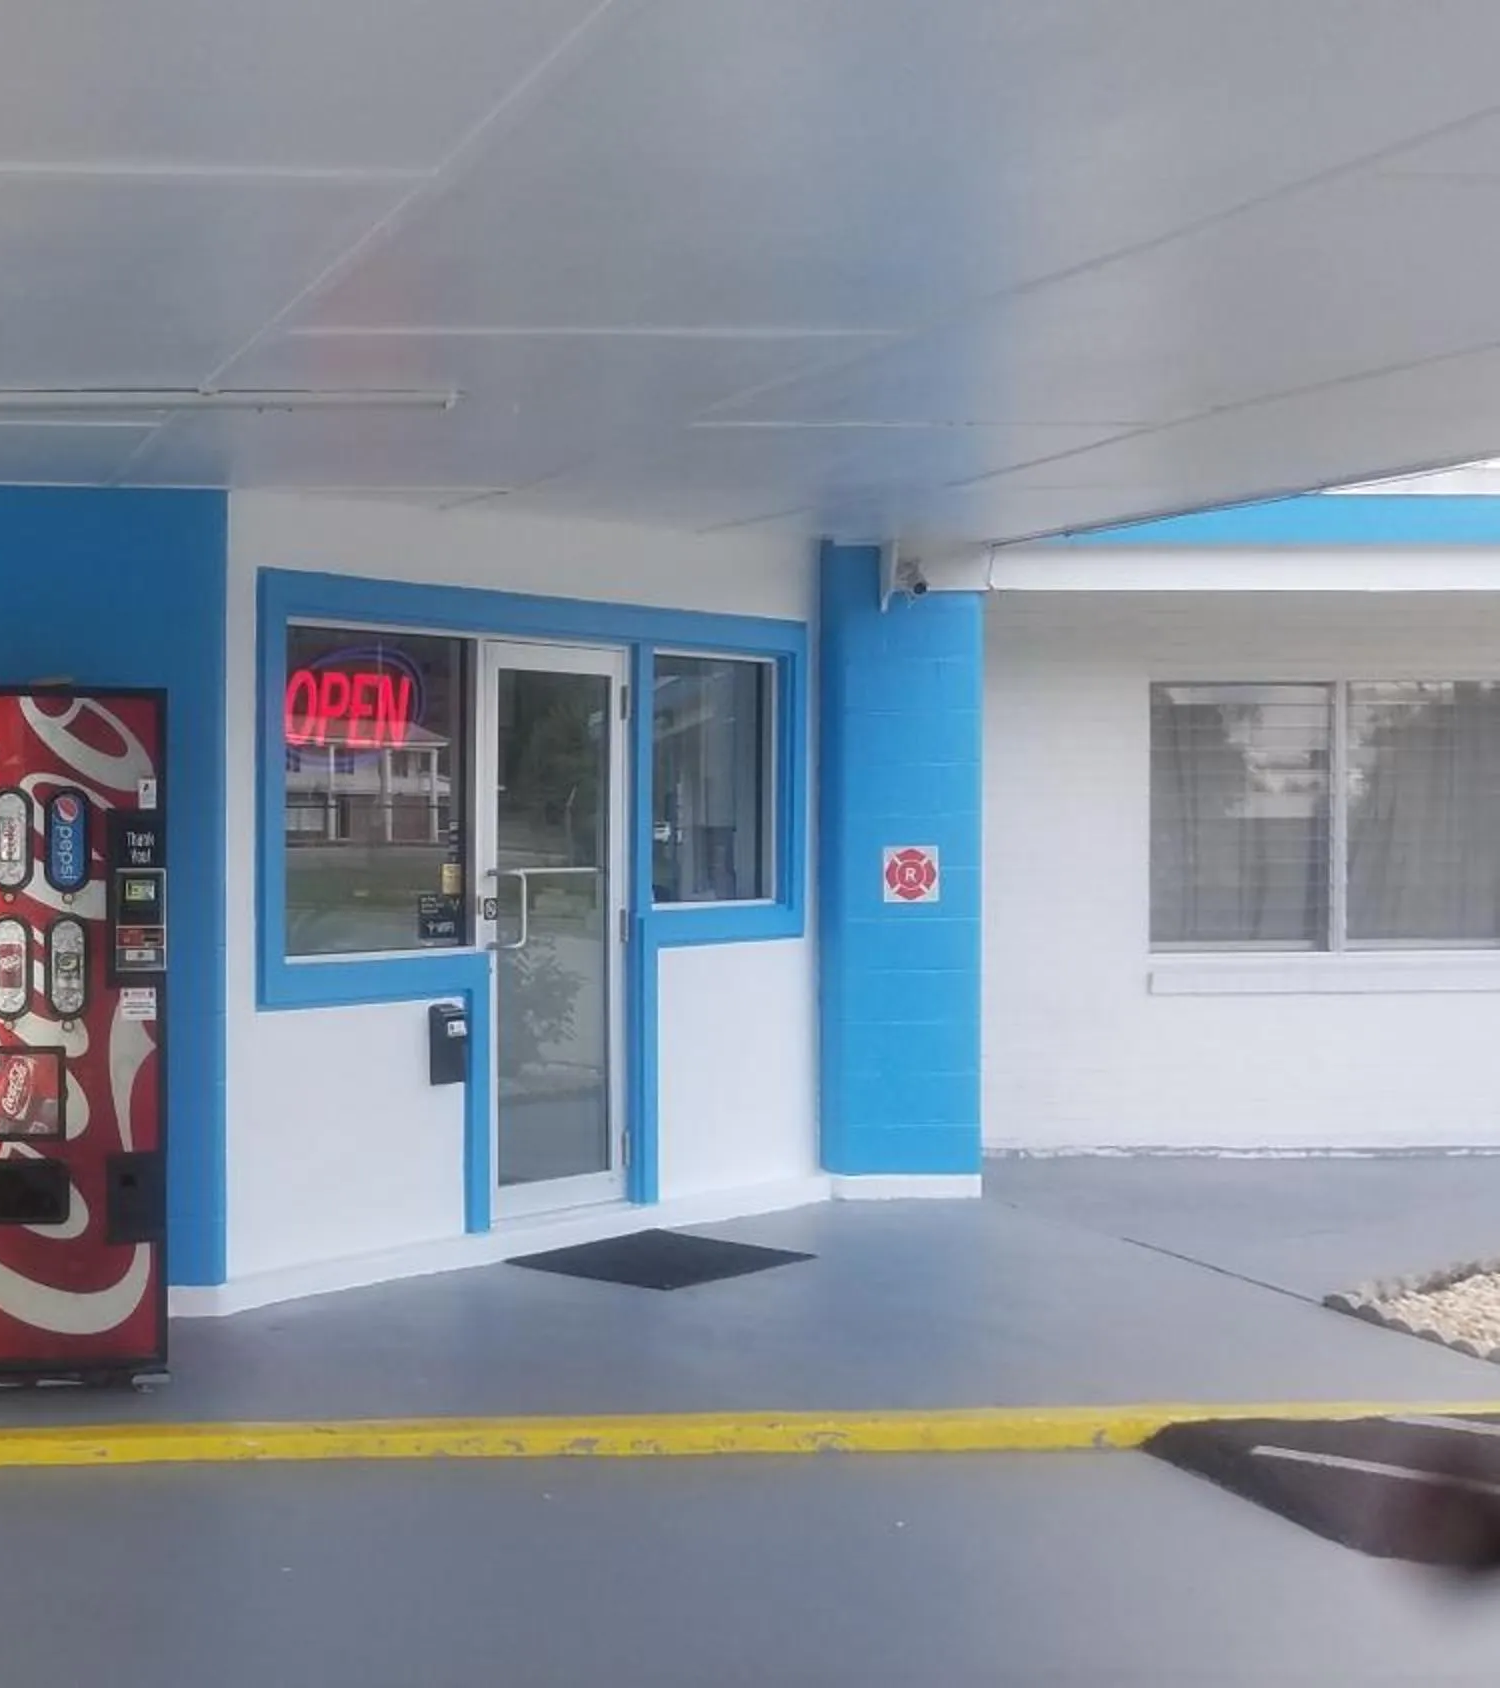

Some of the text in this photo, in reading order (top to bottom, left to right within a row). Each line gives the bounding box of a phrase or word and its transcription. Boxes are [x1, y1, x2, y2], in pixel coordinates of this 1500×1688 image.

[285, 669, 411, 749] OPEN
[56, 822, 79, 880] pepsi
[126, 831, 155, 847] Thank
[905, 867, 917, 883] R
